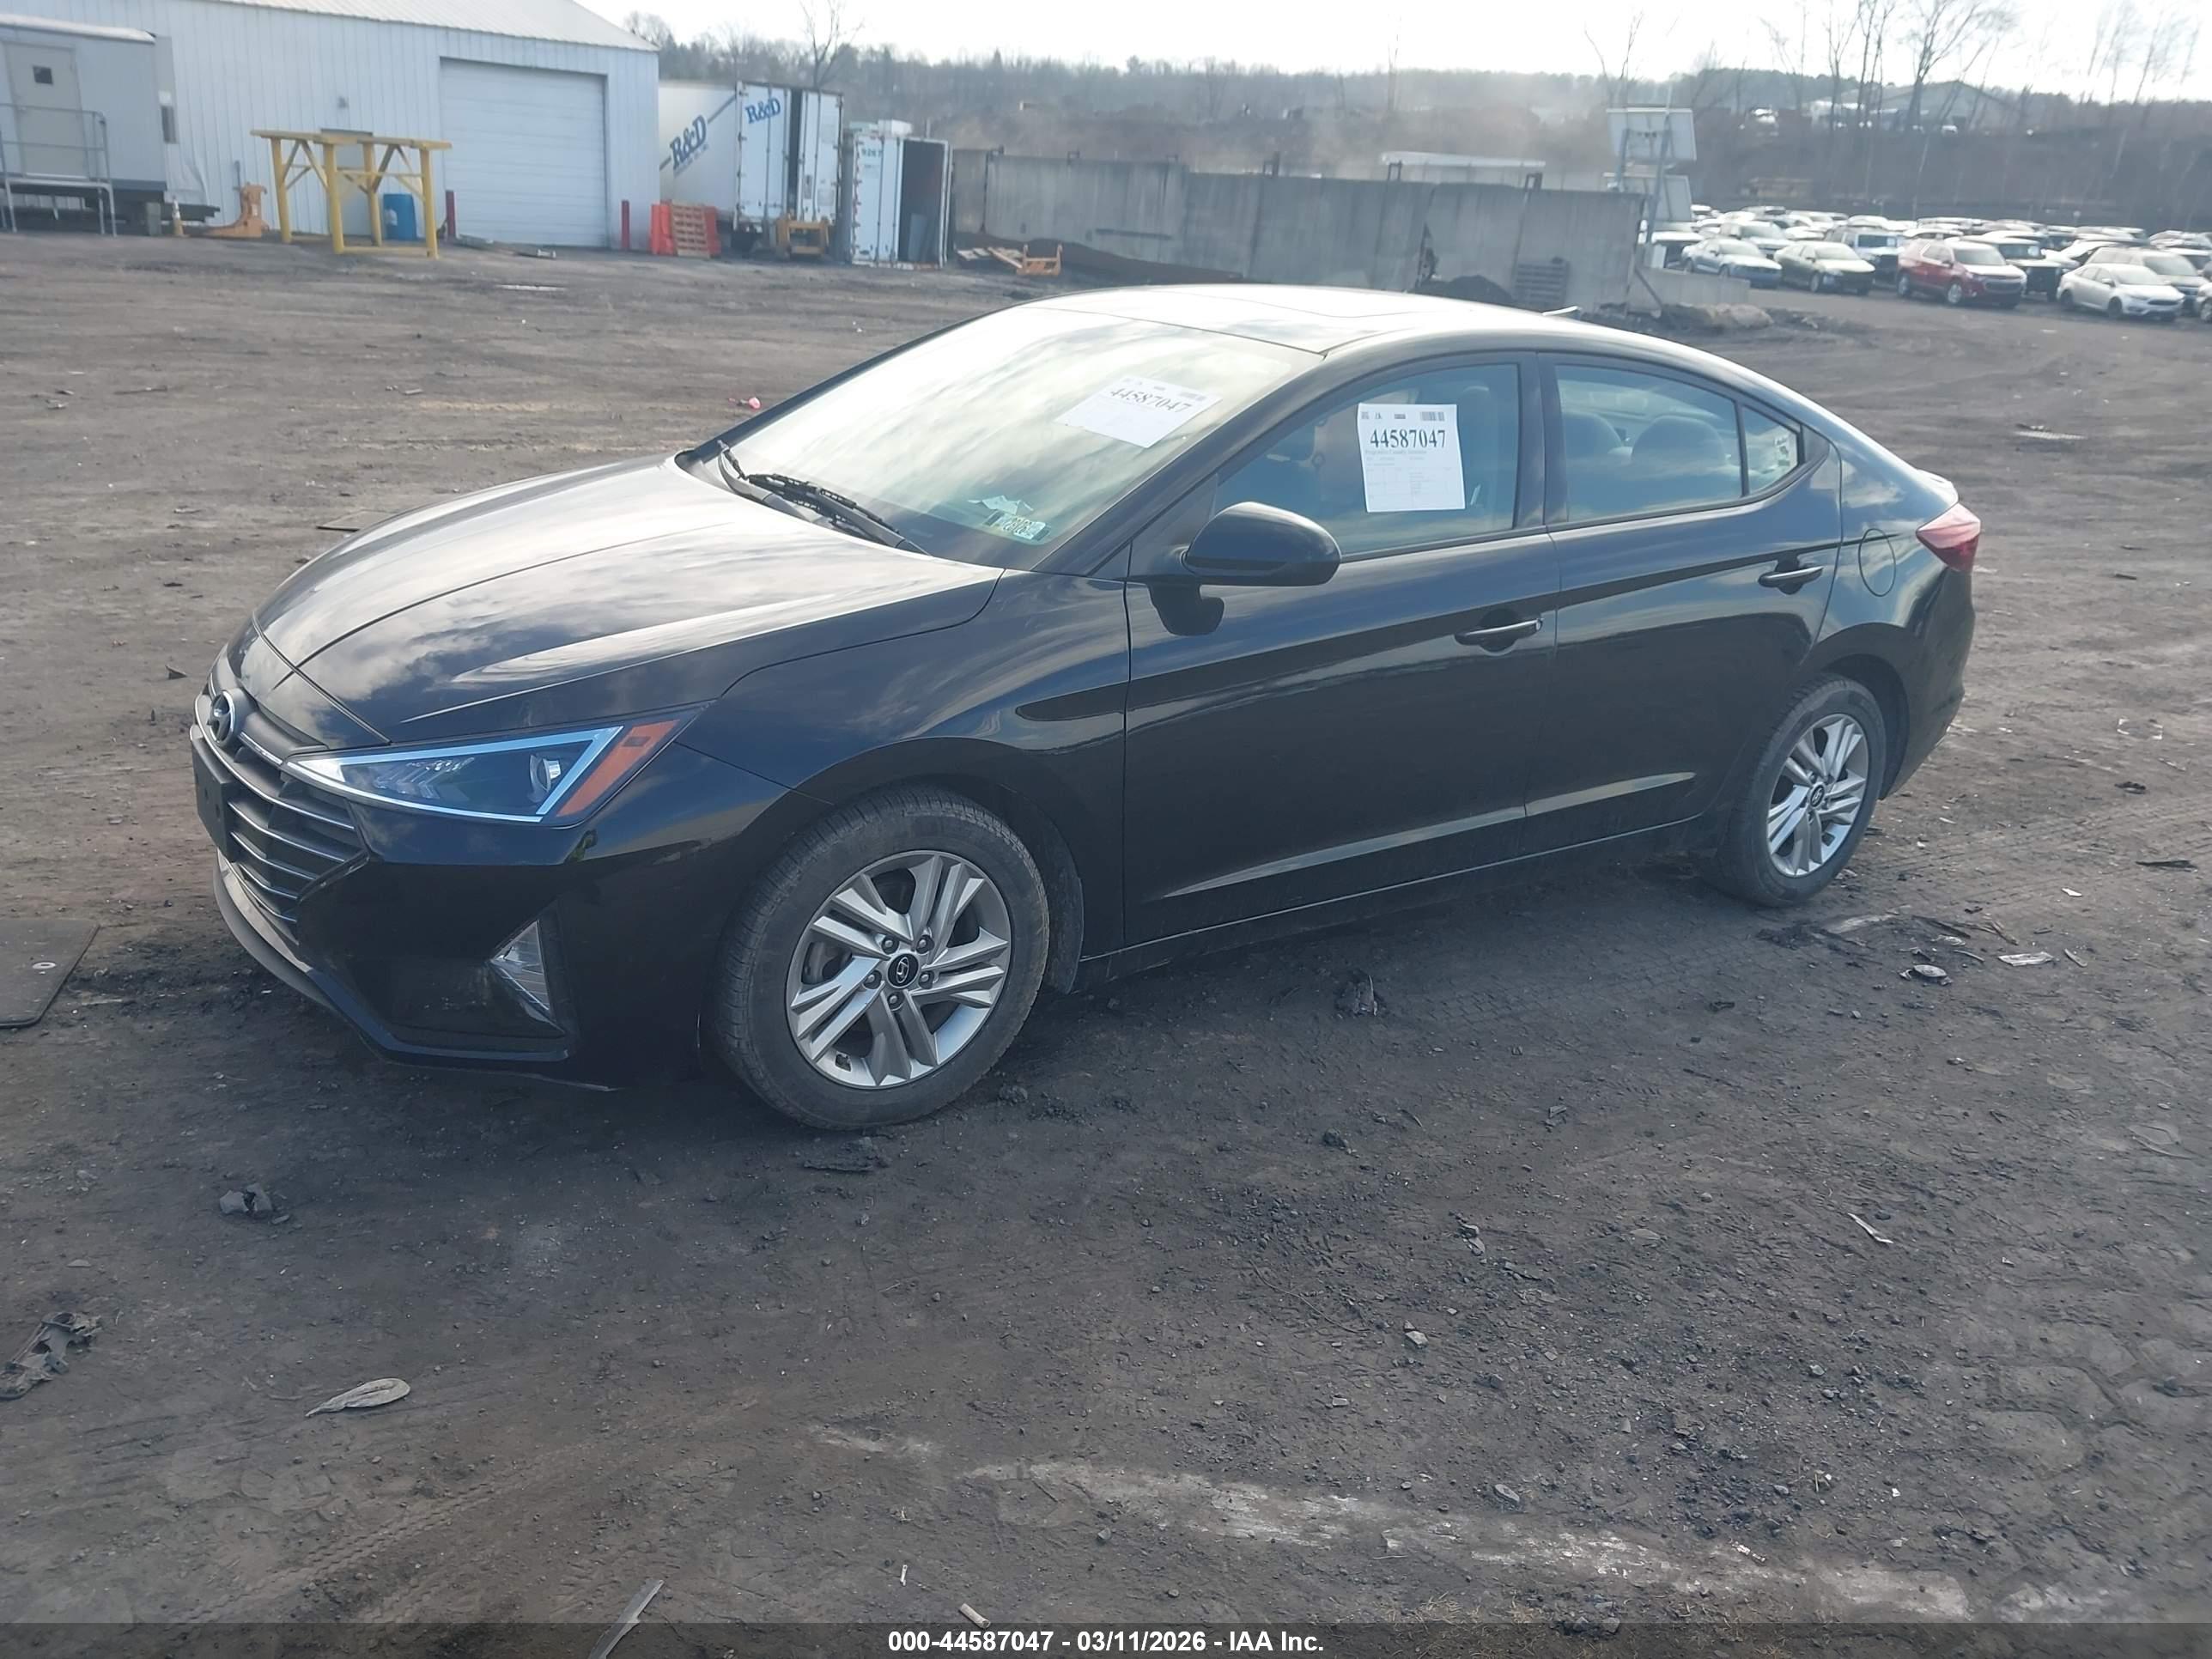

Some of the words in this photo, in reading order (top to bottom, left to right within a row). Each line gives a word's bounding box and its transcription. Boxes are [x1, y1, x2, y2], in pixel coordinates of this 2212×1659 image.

[745, 97, 781, 124] R&D
[670, 115, 707, 170] R&D
[1110, 388, 1194, 413] 44587047
[1370, 428, 1446, 448] 44587047
